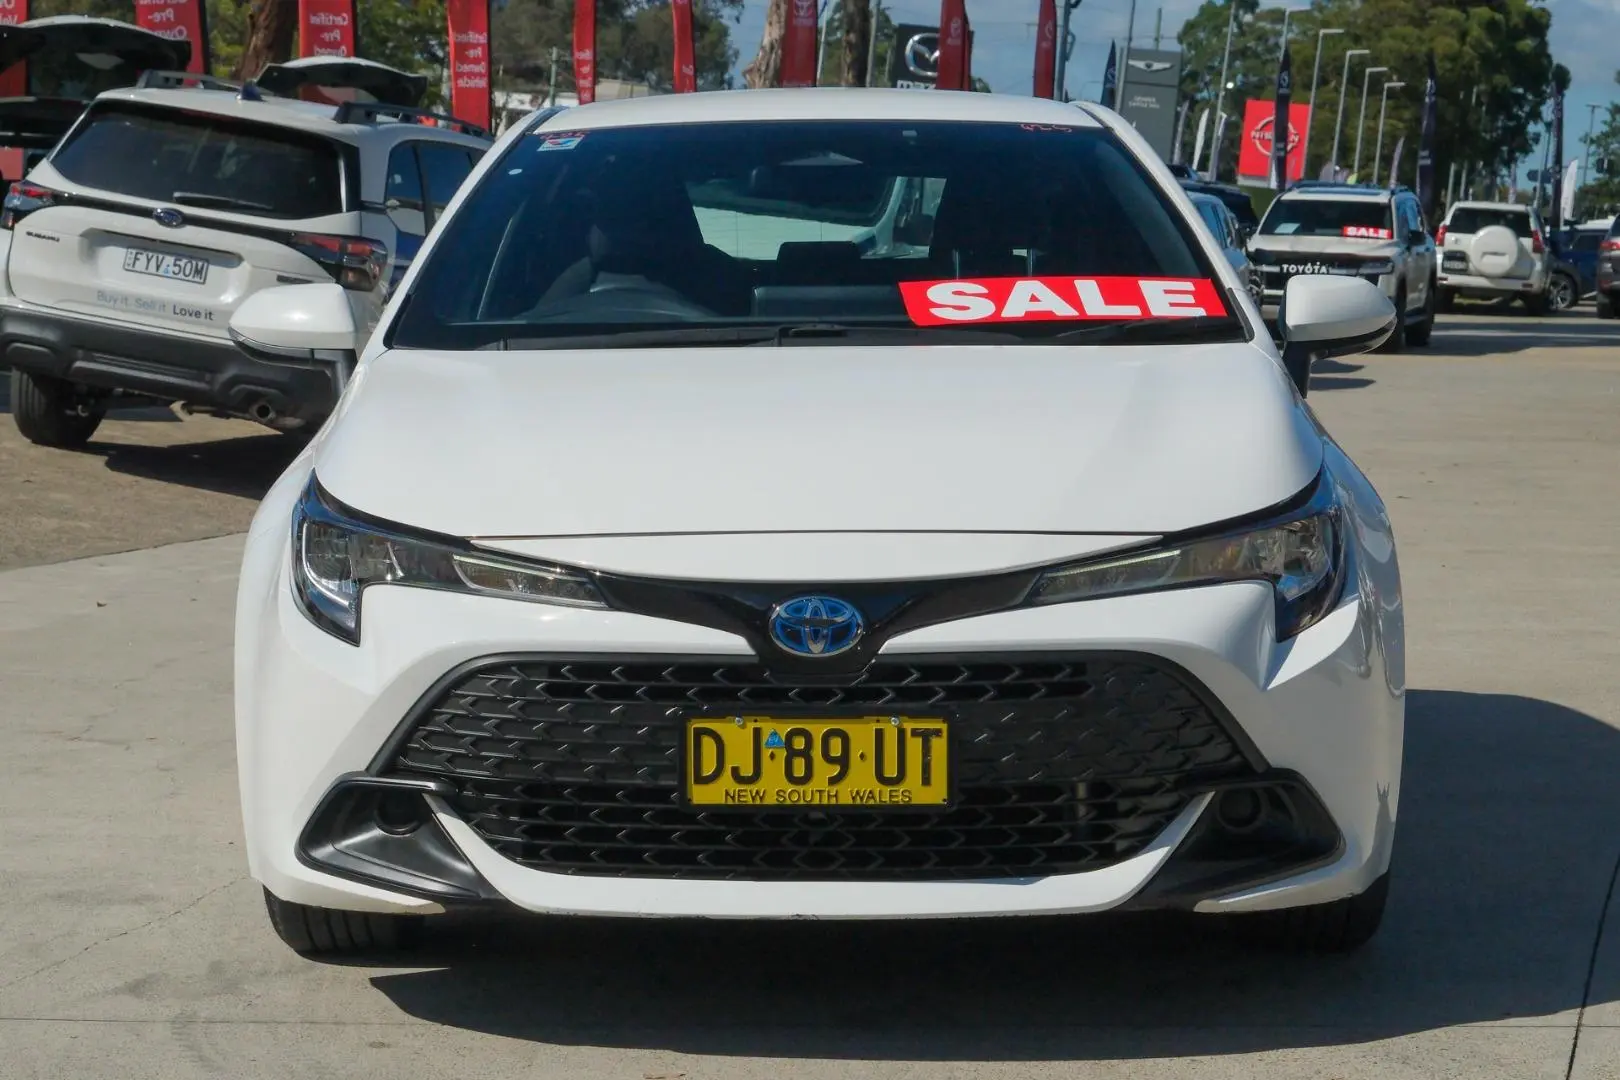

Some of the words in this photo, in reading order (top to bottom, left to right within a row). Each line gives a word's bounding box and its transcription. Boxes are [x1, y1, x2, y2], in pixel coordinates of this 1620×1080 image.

[1346, 226, 1389, 238] SALE
[1281, 262, 1328, 274] TOYOTA
[925, 279, 1207, 320] SALE
[173, 304, 202, 319] Love
[204, 308, 214, 321] it
[724, 788, 766, 804] NEW
[775, 788, 839, 804] SOUTH
[850, 788, 912, 804] WALES
